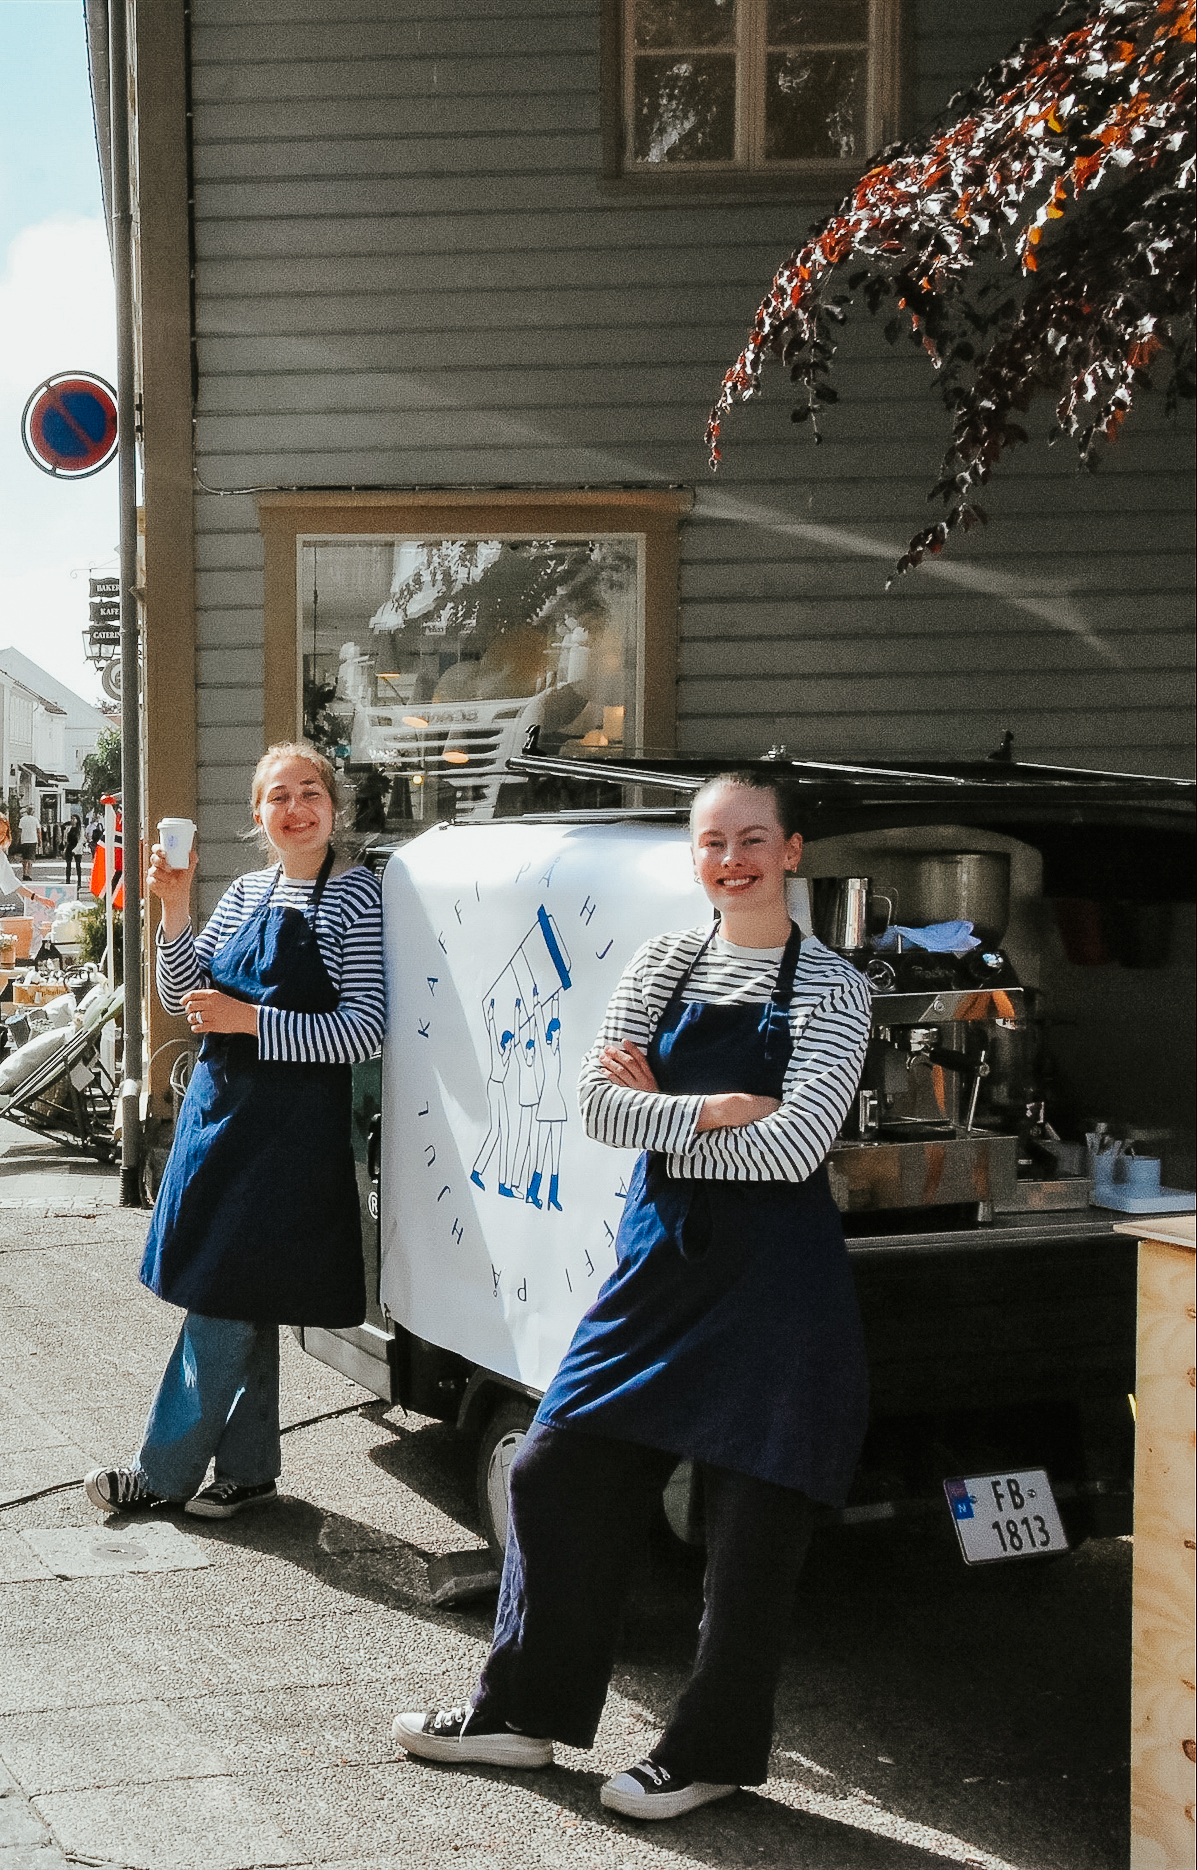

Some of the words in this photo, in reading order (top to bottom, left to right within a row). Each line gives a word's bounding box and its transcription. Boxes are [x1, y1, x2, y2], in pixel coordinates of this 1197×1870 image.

[96, 584, 120, 592] BAKER
[100, 608, 120, 616] KAFE
[93, 631, 122, 639] CATERIN
[579, 895, 614, 960] HJ
[565, 1176, 628, 1293] AFFI
[990, 1478, 1026, 1512] FB
[991, 1515, 1051, 1552] 1813
